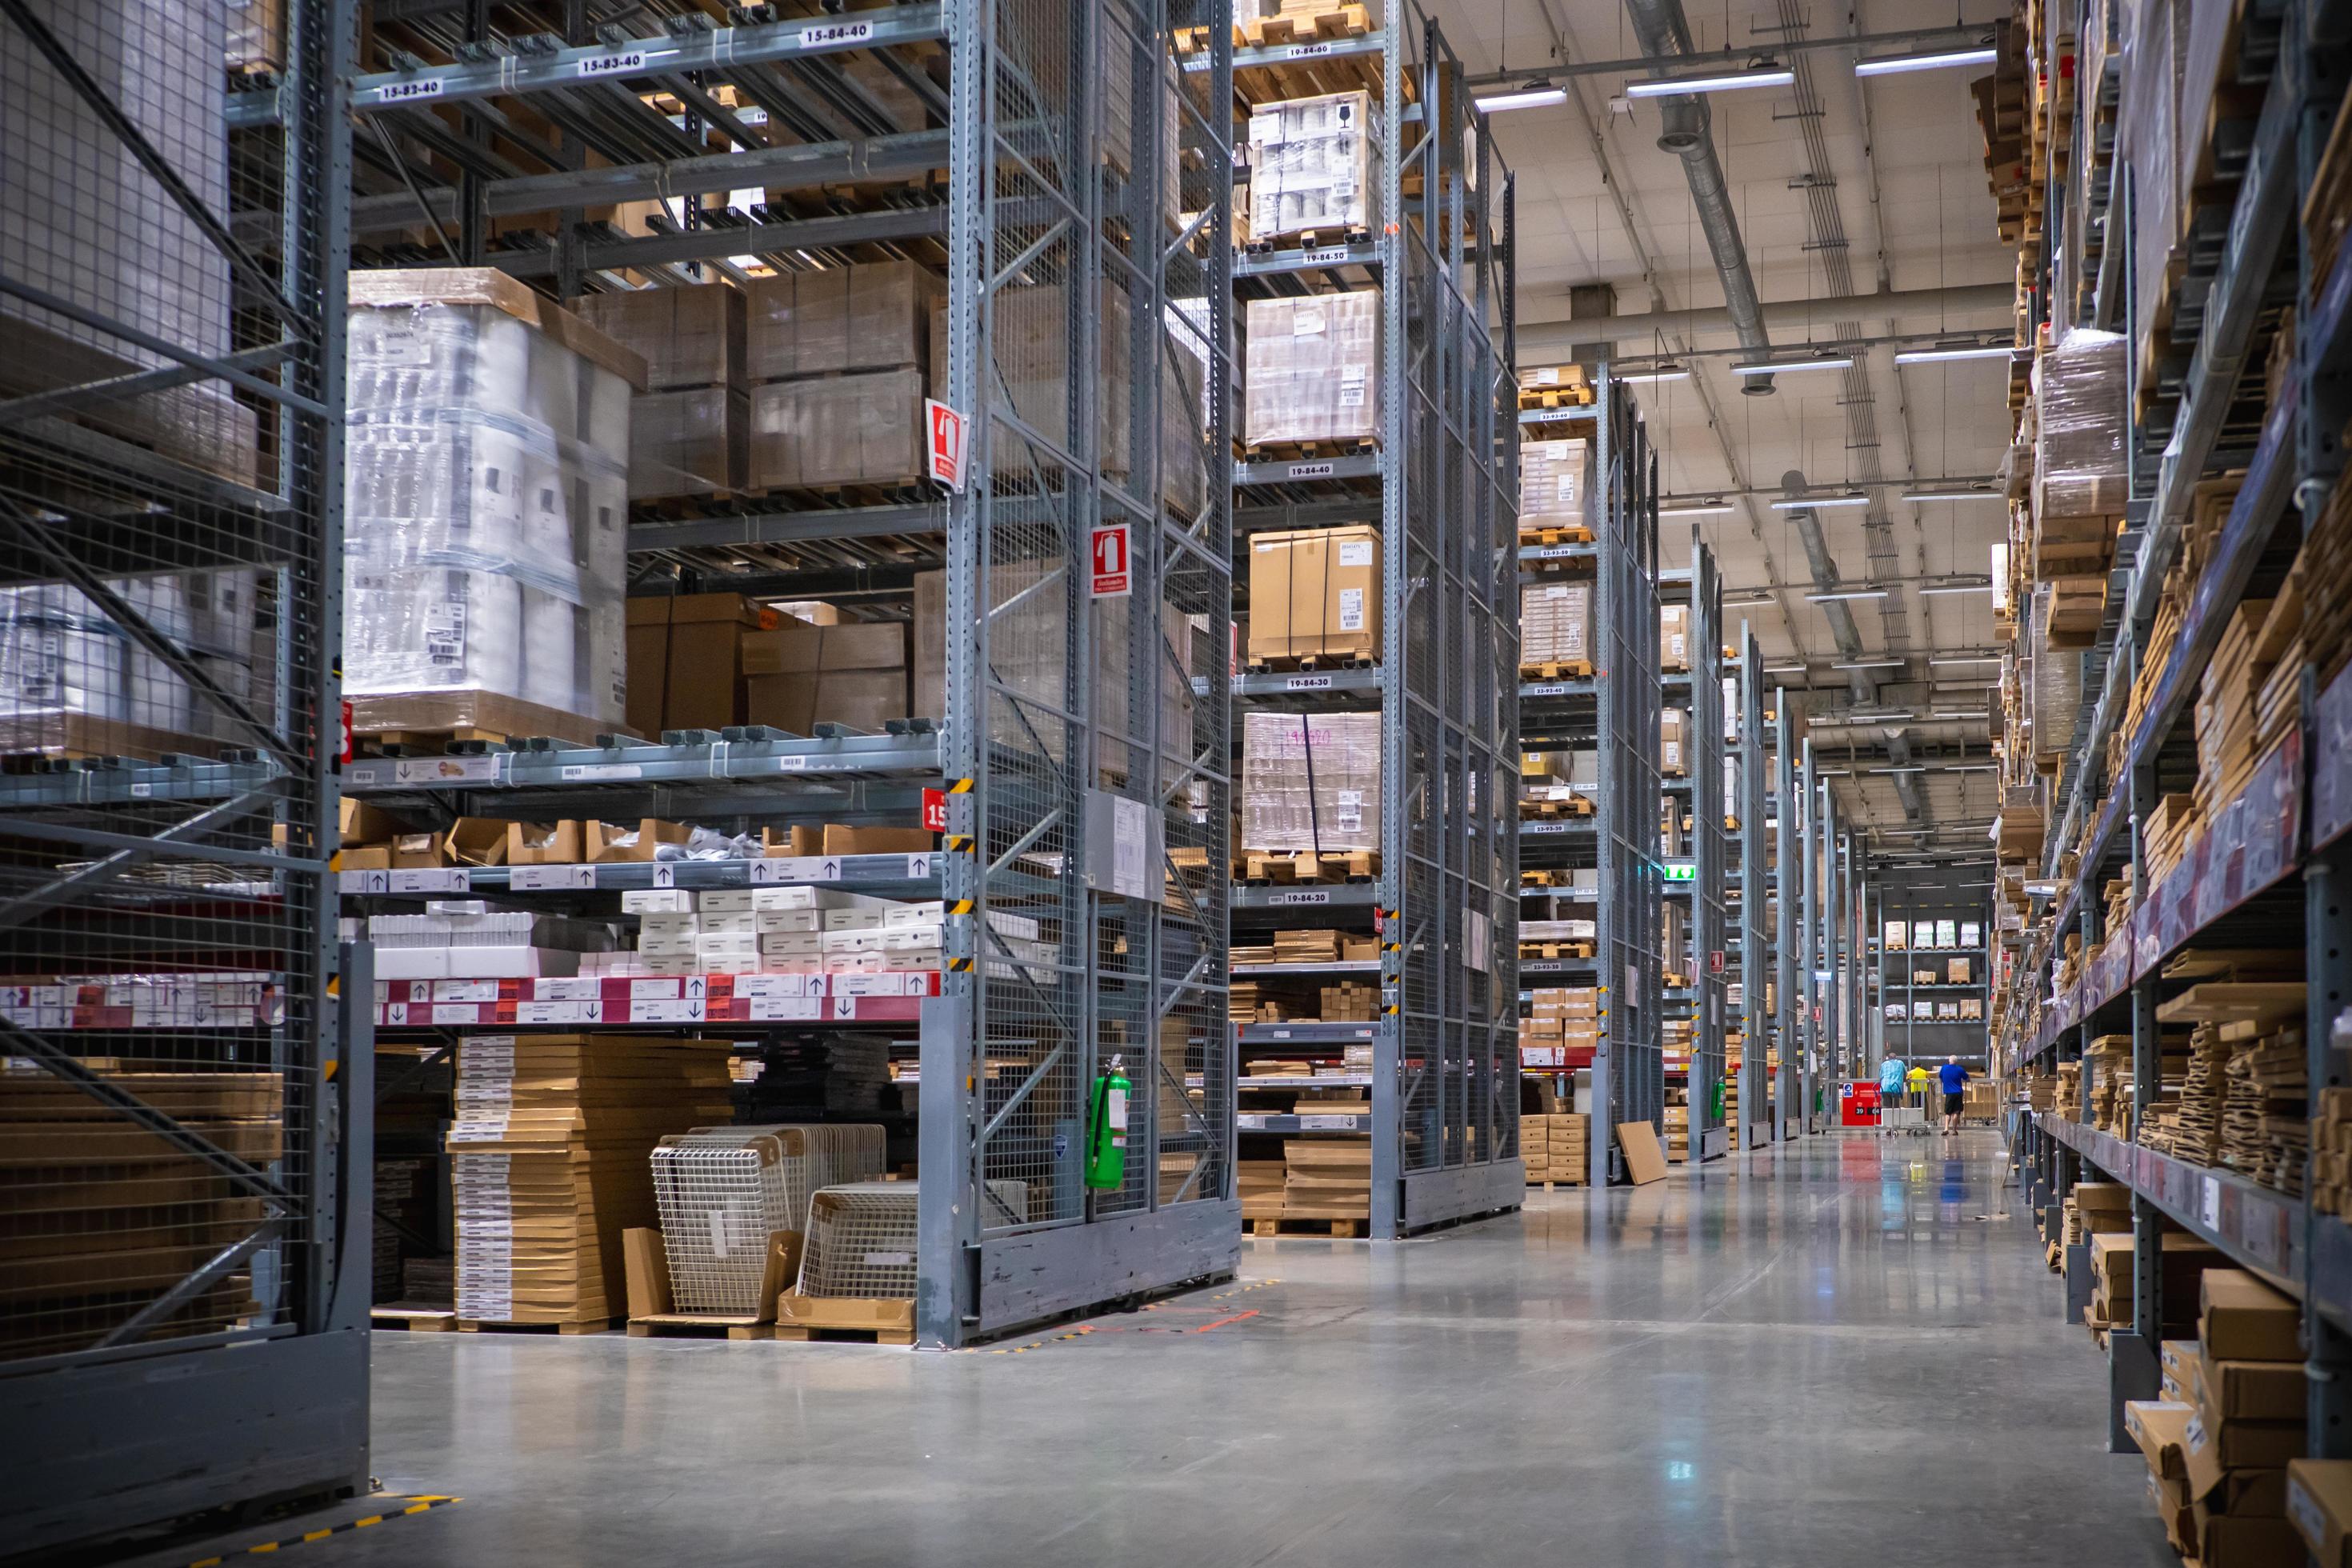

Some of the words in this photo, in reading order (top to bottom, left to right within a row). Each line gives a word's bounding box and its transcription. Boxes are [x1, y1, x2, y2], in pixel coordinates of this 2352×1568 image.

[808, 25, 867, 42] 15-84-40
[1290, 45, 1328, 56] 19-84-60
[583, 54, 640, 72] 15-83-40
[1306, 252, 1345, 262] 19-84-50
[1292, 466, 1330, 476] 19-84-40
[1291, 678, 1329, 688] 19-84-30
[1287, 894, 1326, 902] 19-84-20
[1375, 917, 1382, 930] 19
